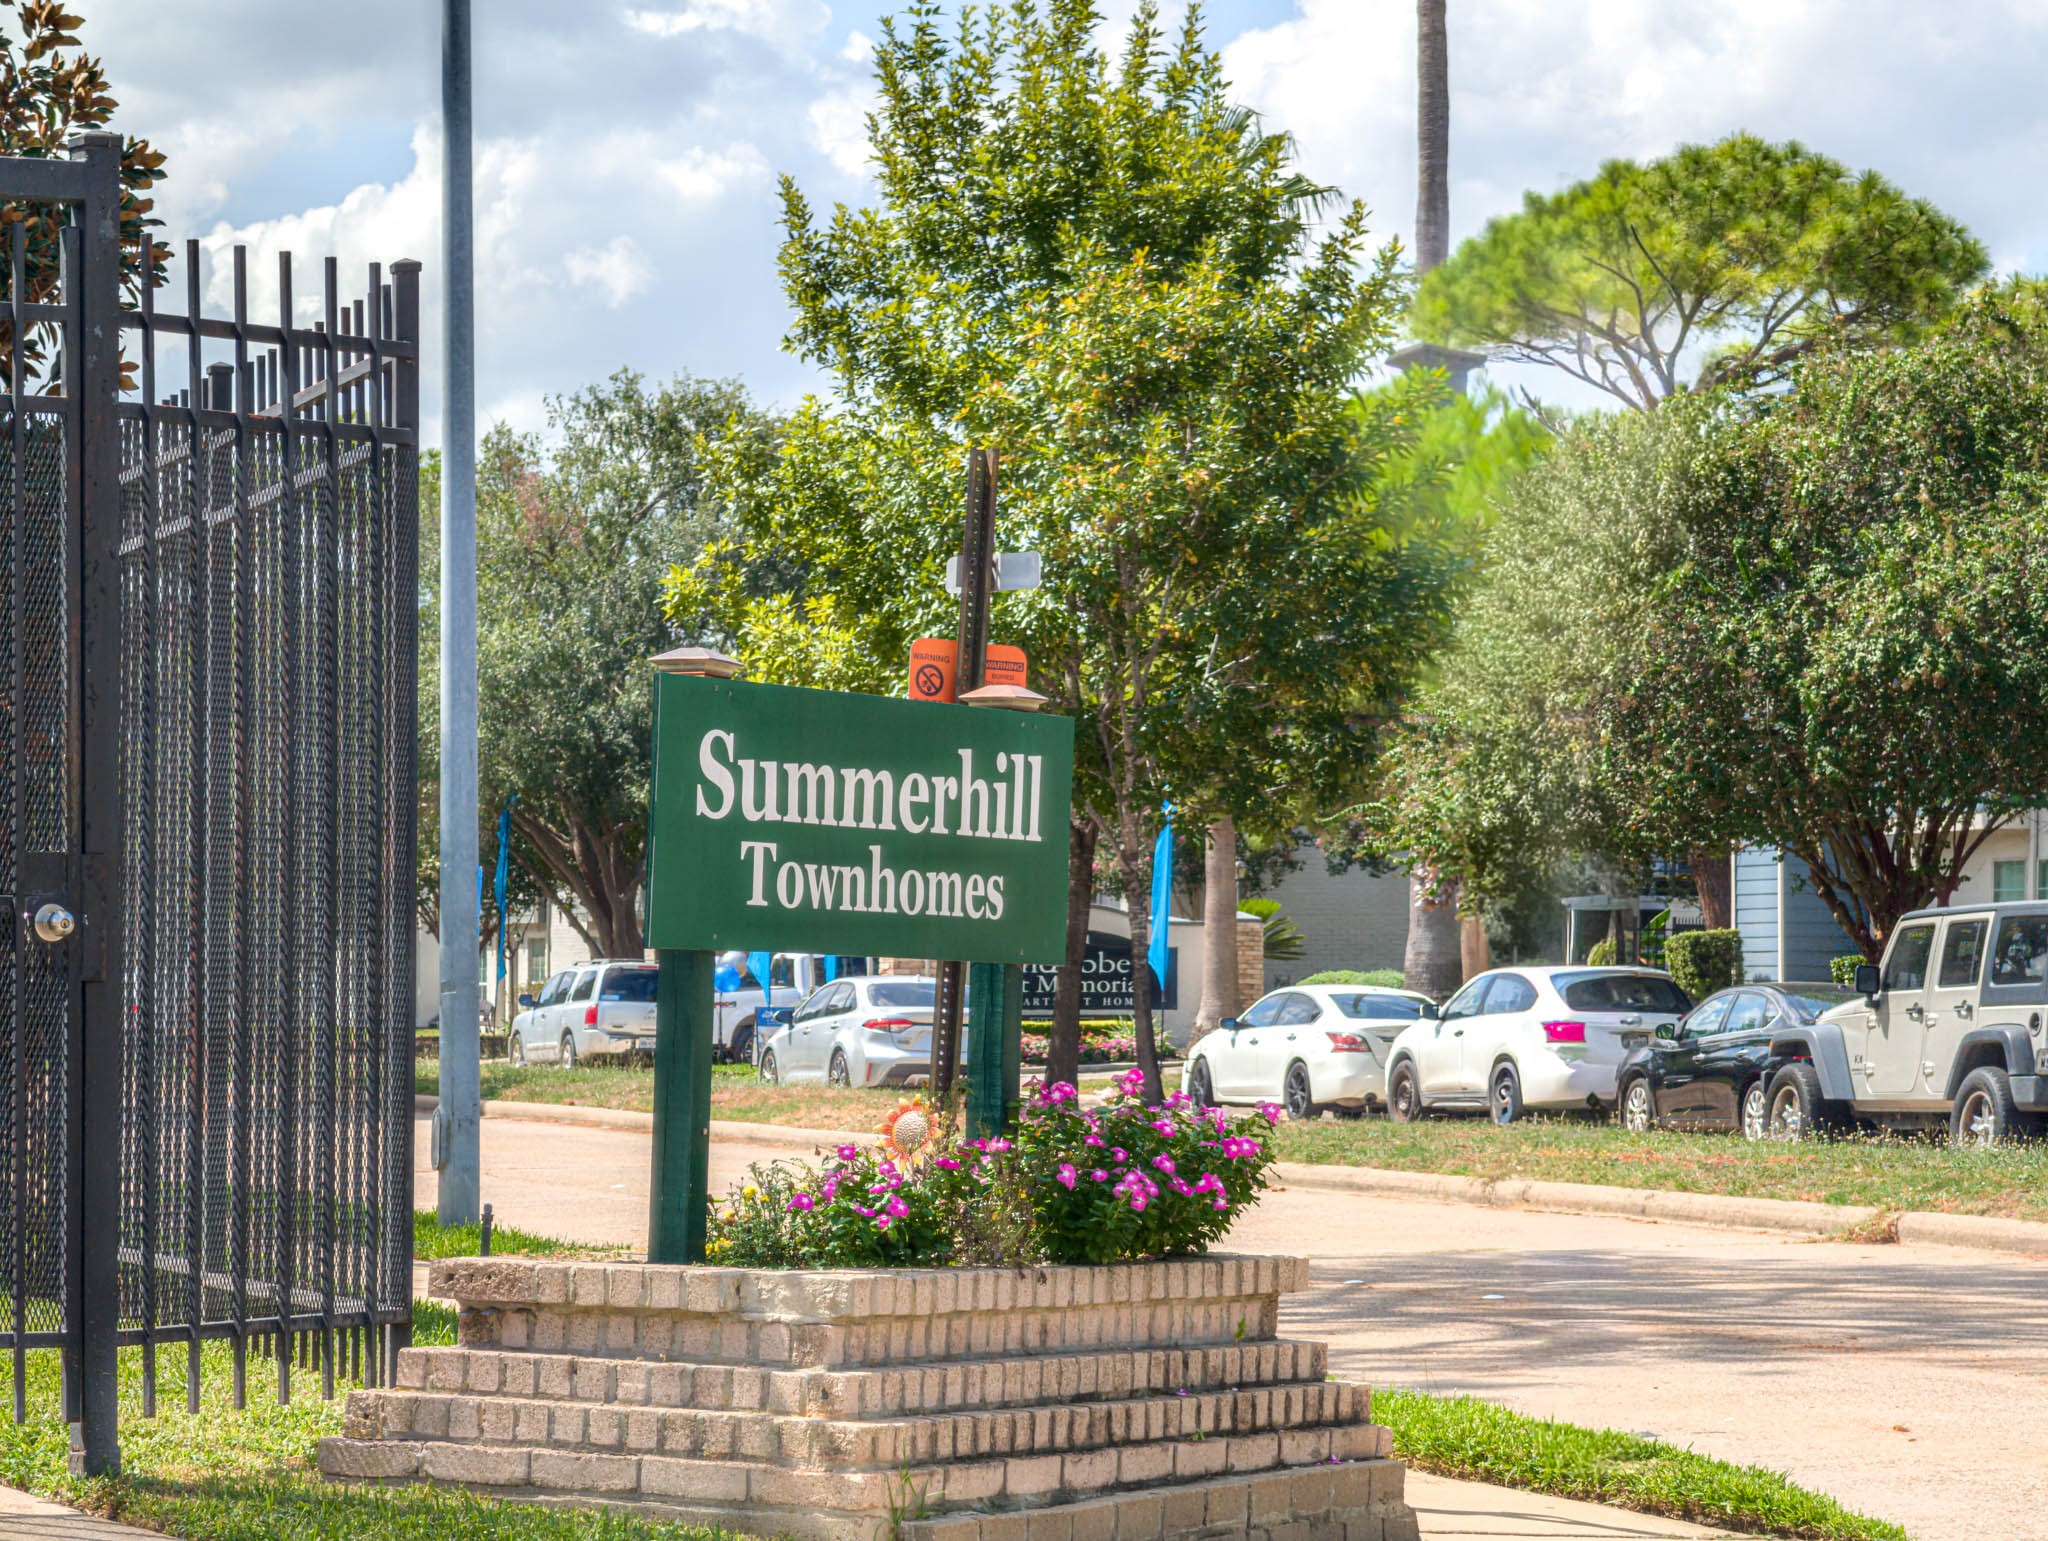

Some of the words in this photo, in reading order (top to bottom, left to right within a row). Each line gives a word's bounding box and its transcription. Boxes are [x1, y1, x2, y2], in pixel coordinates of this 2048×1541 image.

[912, 653, 951, 663] WARNING
[986, 660, 1023, 671] WARNING
[696, 729, 1042, 842] Summerhill
[740, 841, 1004, 920] Townhomes
[1036, 975, 1135, 993] Mmoria
[1102, 997, 1134, 1007] HOM
